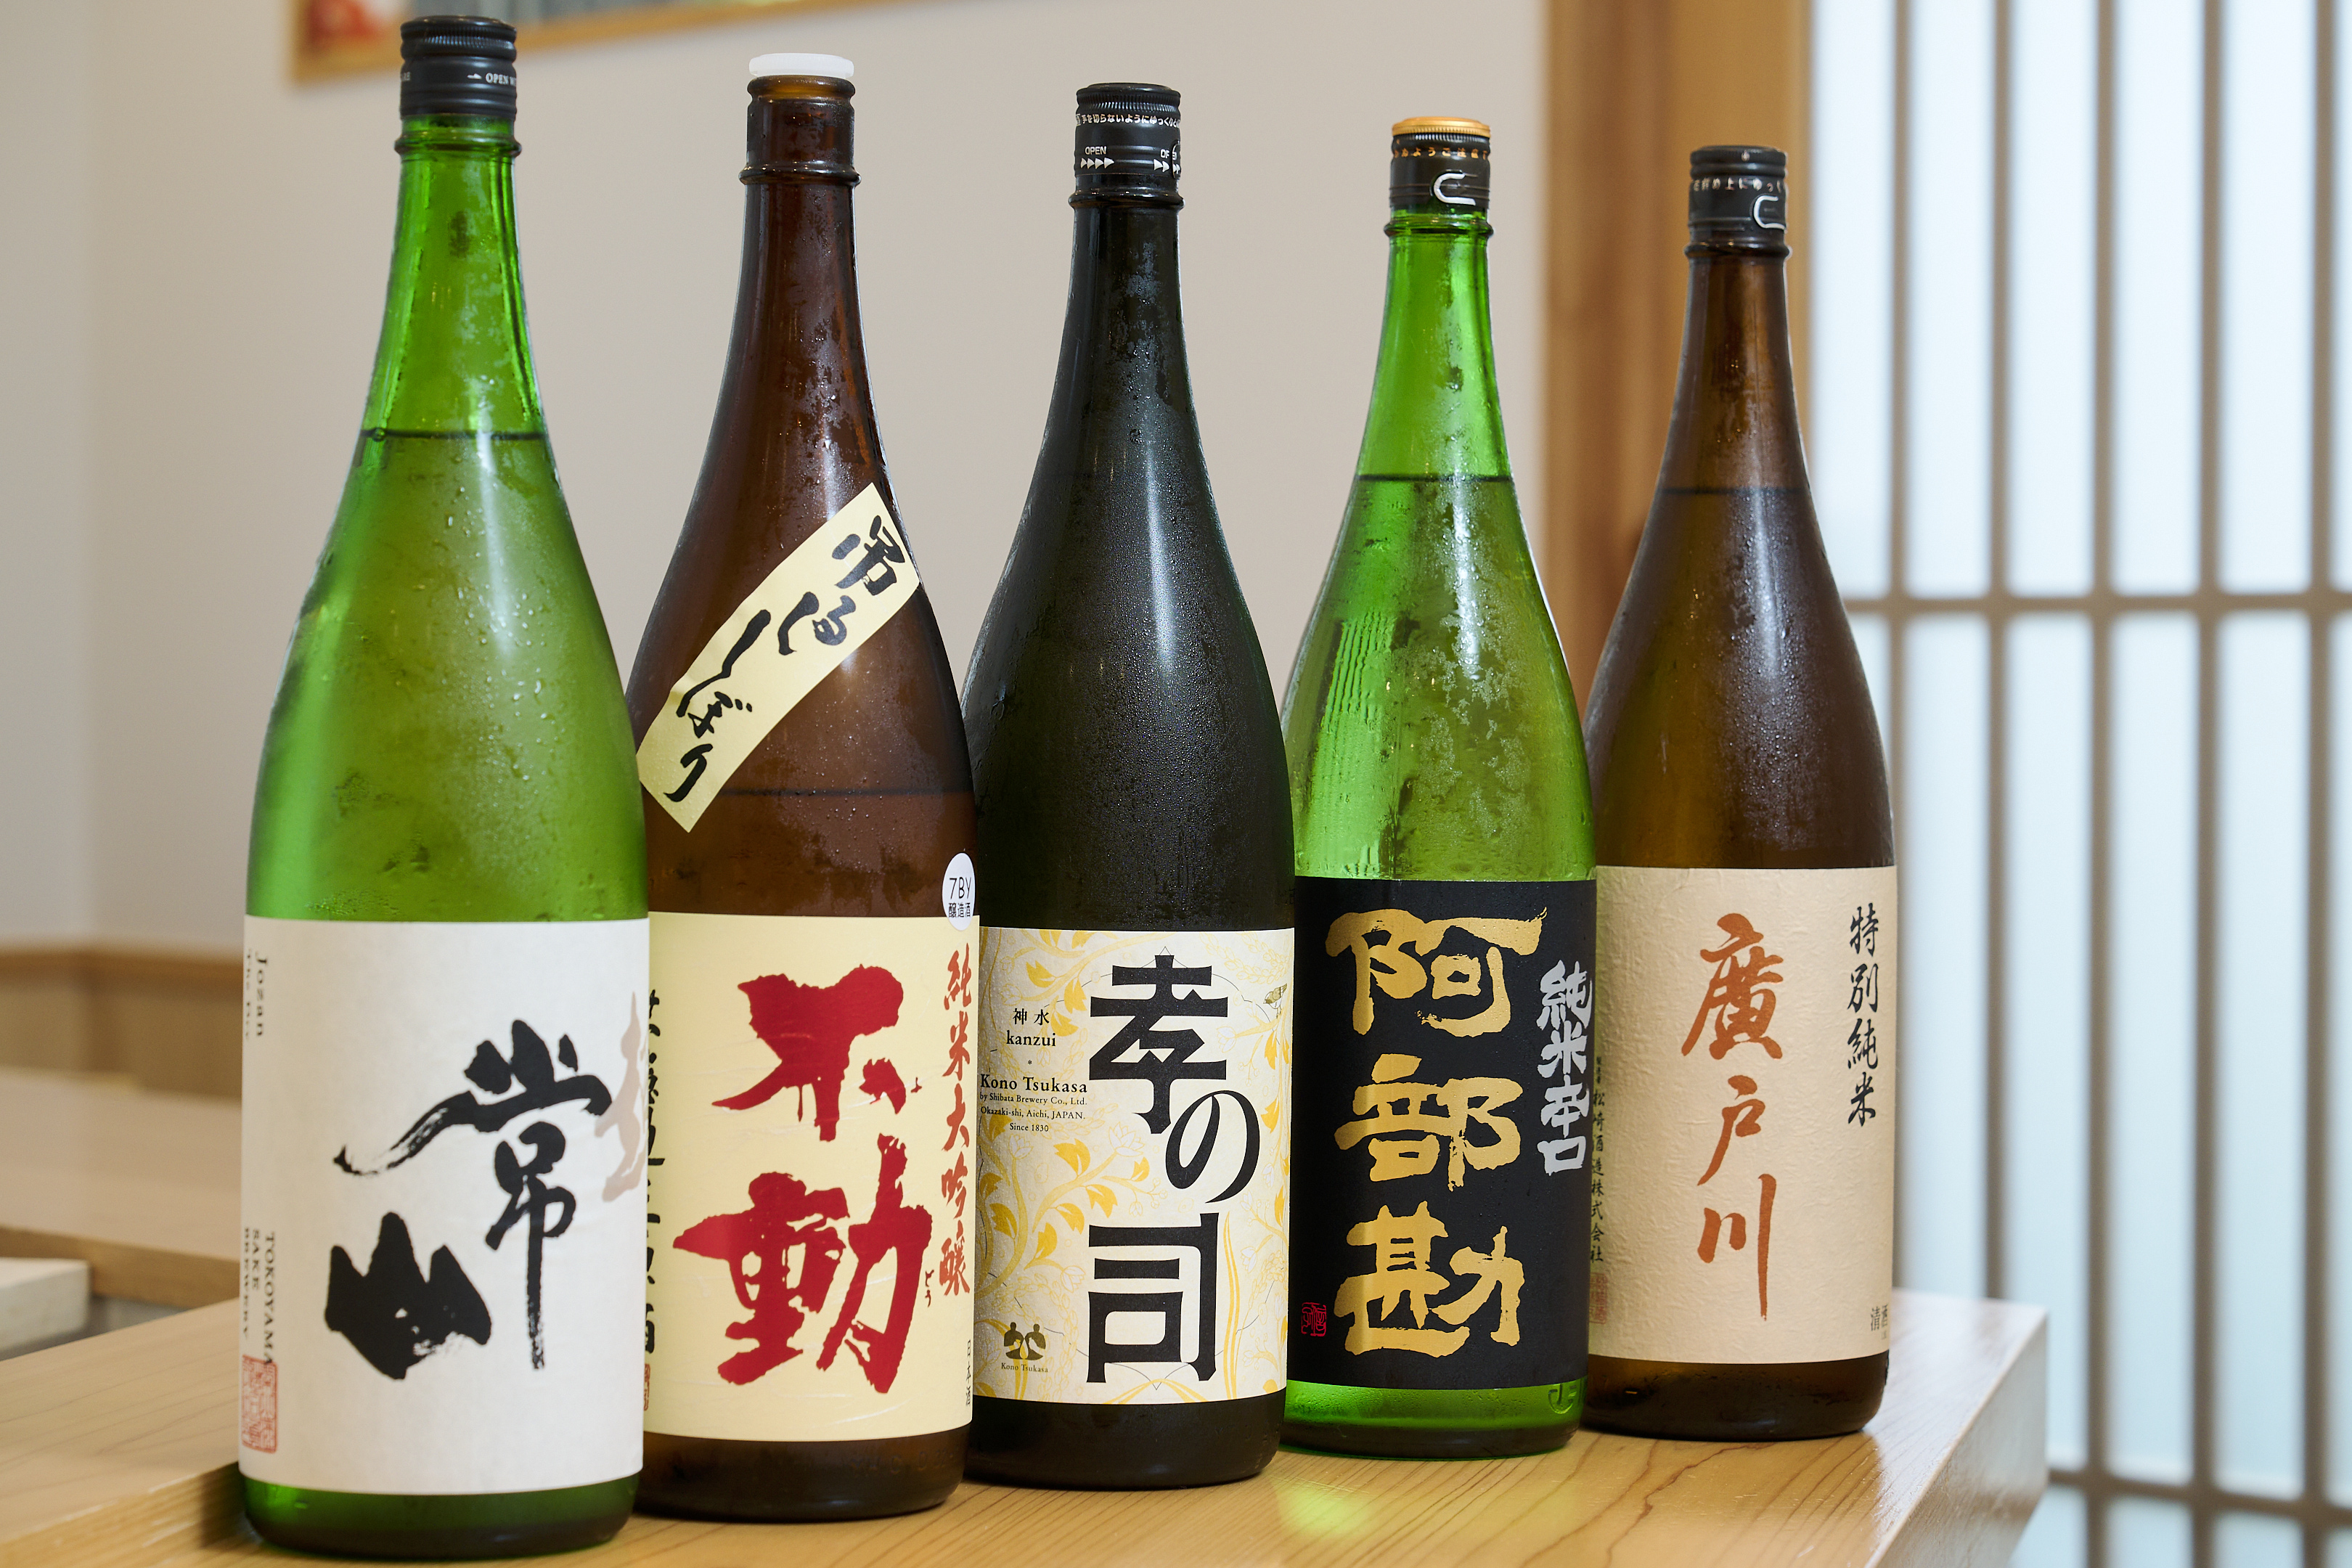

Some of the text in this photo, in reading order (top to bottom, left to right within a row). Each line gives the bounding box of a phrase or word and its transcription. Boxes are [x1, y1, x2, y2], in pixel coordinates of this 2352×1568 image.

[486, 73, 509, 84] OPEN
[1085, 146, 1107, 155] OPEN
[949, 876, 972, 899] 7BY
[256, 950, 268, 1036] Jozan
[1012, 1008, 1050, 1026] 神水
[1846, 902, 1879, 1127] 特別純米
[1006, 1029, 1056, 1047] kanzui
[980, 1074, 1087, 1093] Kono Tsukasa
[1537, 960, 1592, 1176] 純米辛口
[939, 942, 973, 1297] 純米大吟醸
[979, 1091, 1087, 1106] by Shibata Brewery Co., Ltd.
[980, 1106, 1085, 1119] Okazaki-shi, Aichi, JAPAN.
[1681, 912, 1784, 1321] 廣戸川
[1010, 1122, 1049, 1132] Since 1830
[1325, 905, 1548, 1357] 阿部勘
[673, 963, 933, 1395] 不動
[1086, 954, 1260, 1384] 孝の司
[325, 1018, 613, 1380] 常山
[264, 1231, 274, 1365] TOKOYAMA
[1001, 1362, 1048, 1373] Kono Tsukasa
